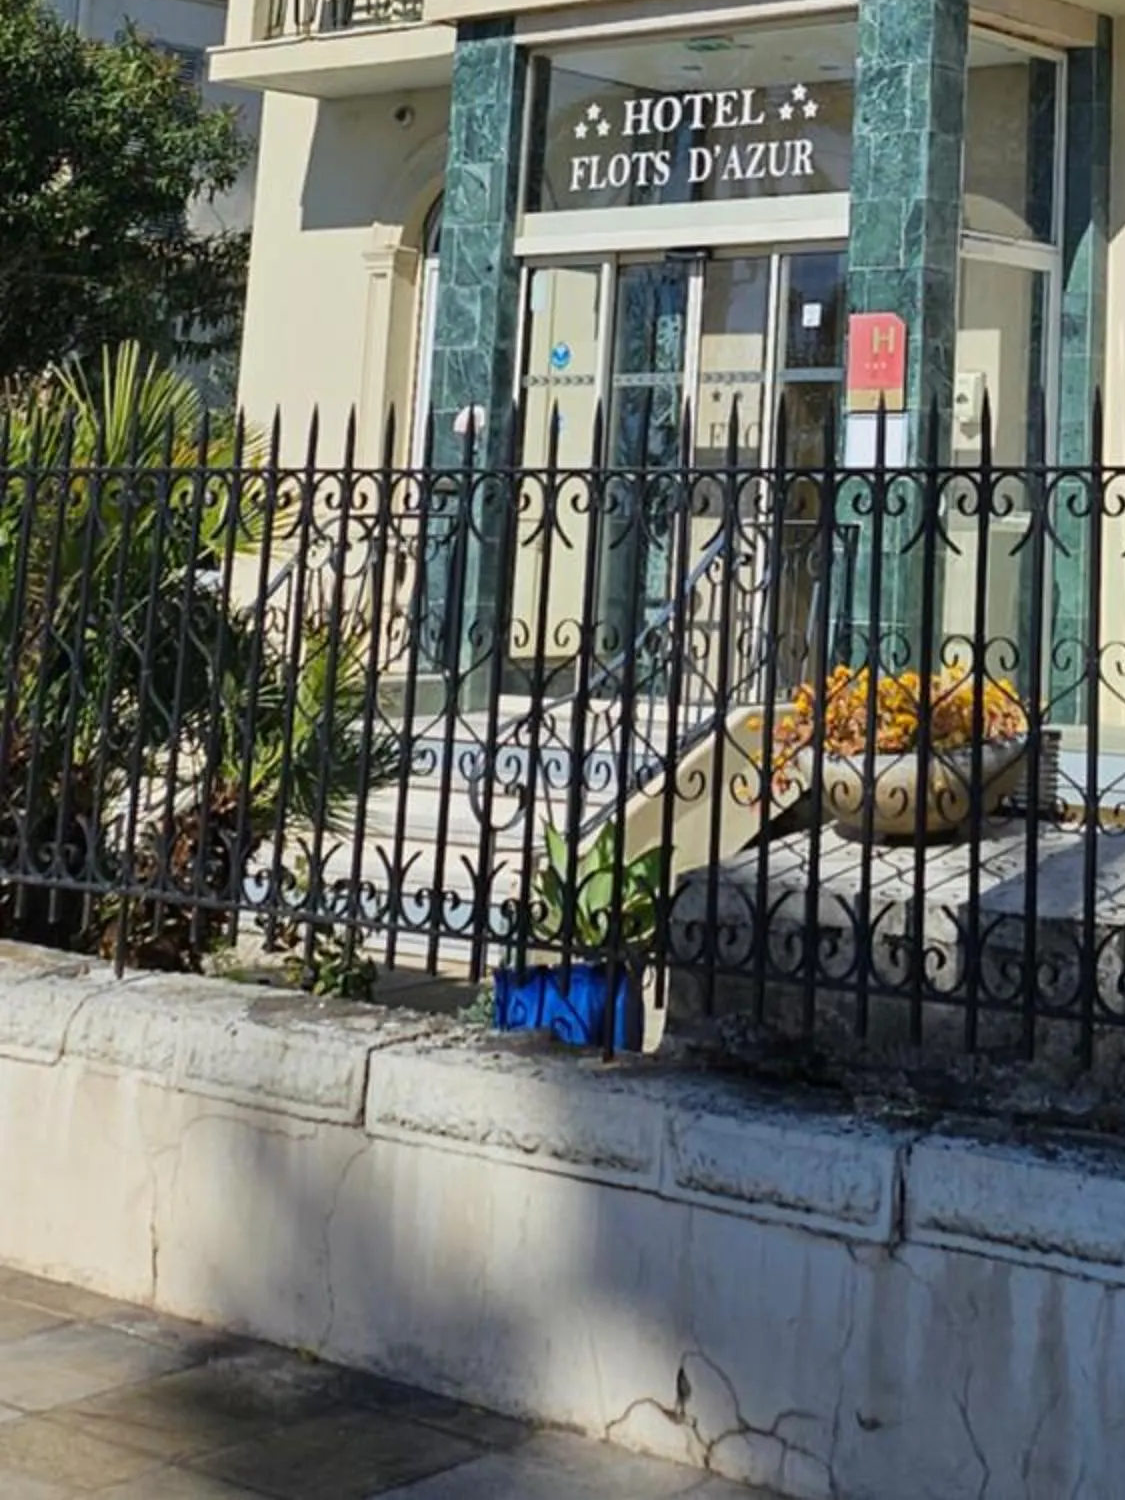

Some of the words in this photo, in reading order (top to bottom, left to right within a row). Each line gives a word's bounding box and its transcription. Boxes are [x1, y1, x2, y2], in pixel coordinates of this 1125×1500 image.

[621, 88, 766, 137] HOTEL
[569, 150, 672, 192] FLOTS
[688, 138, 814, 184] D'AZUR
[872, 325, 896, 354] H
